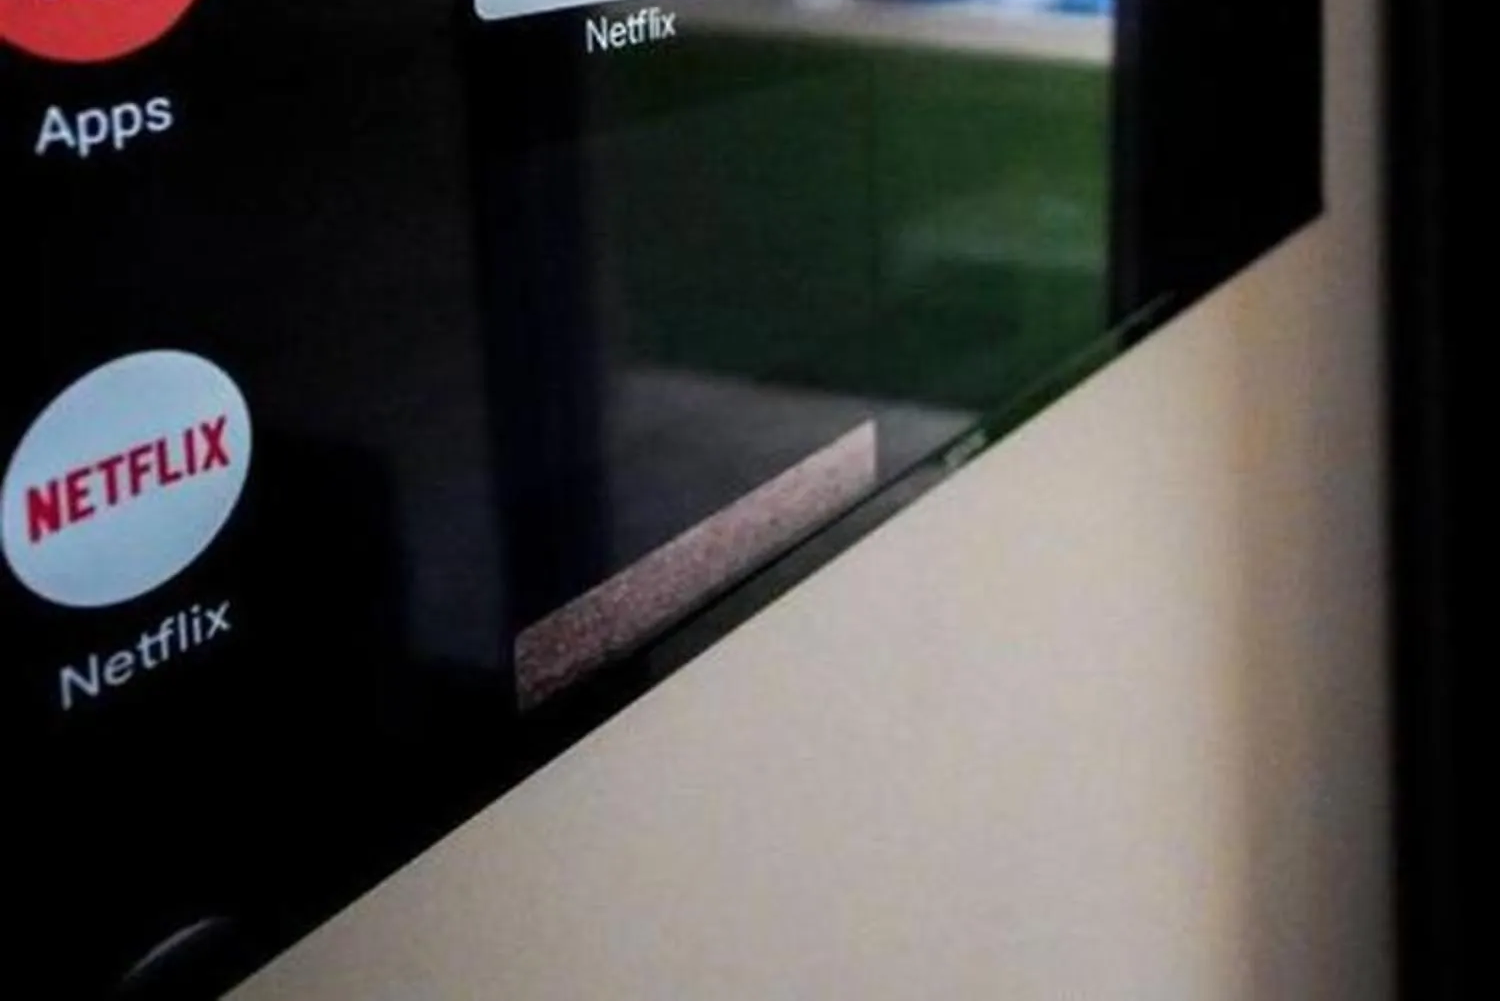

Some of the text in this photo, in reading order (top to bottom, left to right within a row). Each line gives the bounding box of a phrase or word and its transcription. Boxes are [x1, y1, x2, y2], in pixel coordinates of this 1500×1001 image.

[586, 6, 677, 53] Netflix
[34, 96, 175, 157] Apps
[25, 415, 231, 544] NETFLIX
[58, 598, 232, 710] Netflix
